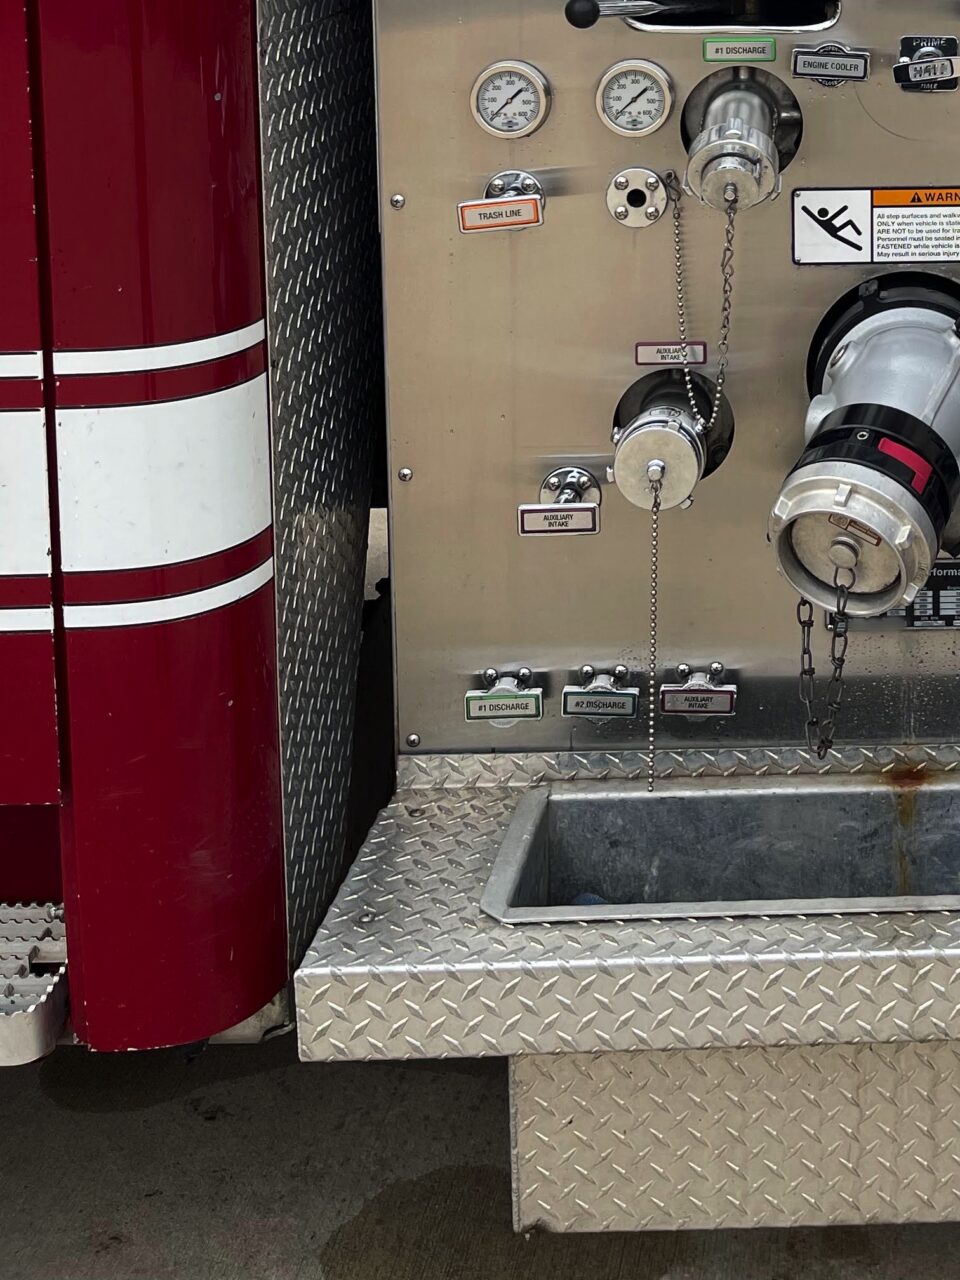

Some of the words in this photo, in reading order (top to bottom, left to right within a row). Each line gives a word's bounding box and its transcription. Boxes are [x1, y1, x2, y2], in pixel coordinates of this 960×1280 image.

[913, 38, 946, 47] PRIME
[726, 46, 767, 55] DISCHARGE
[803, 61, 829, 70] ENGINE
[831, 62, 859, 71] COOLER
[478, 212, 504, 220] TRASH
[506, 209, 522, 218] LINE
[489, 703, 530, 711] DISCHARGE
[586, 701, 626, 710] DISCHARGE
